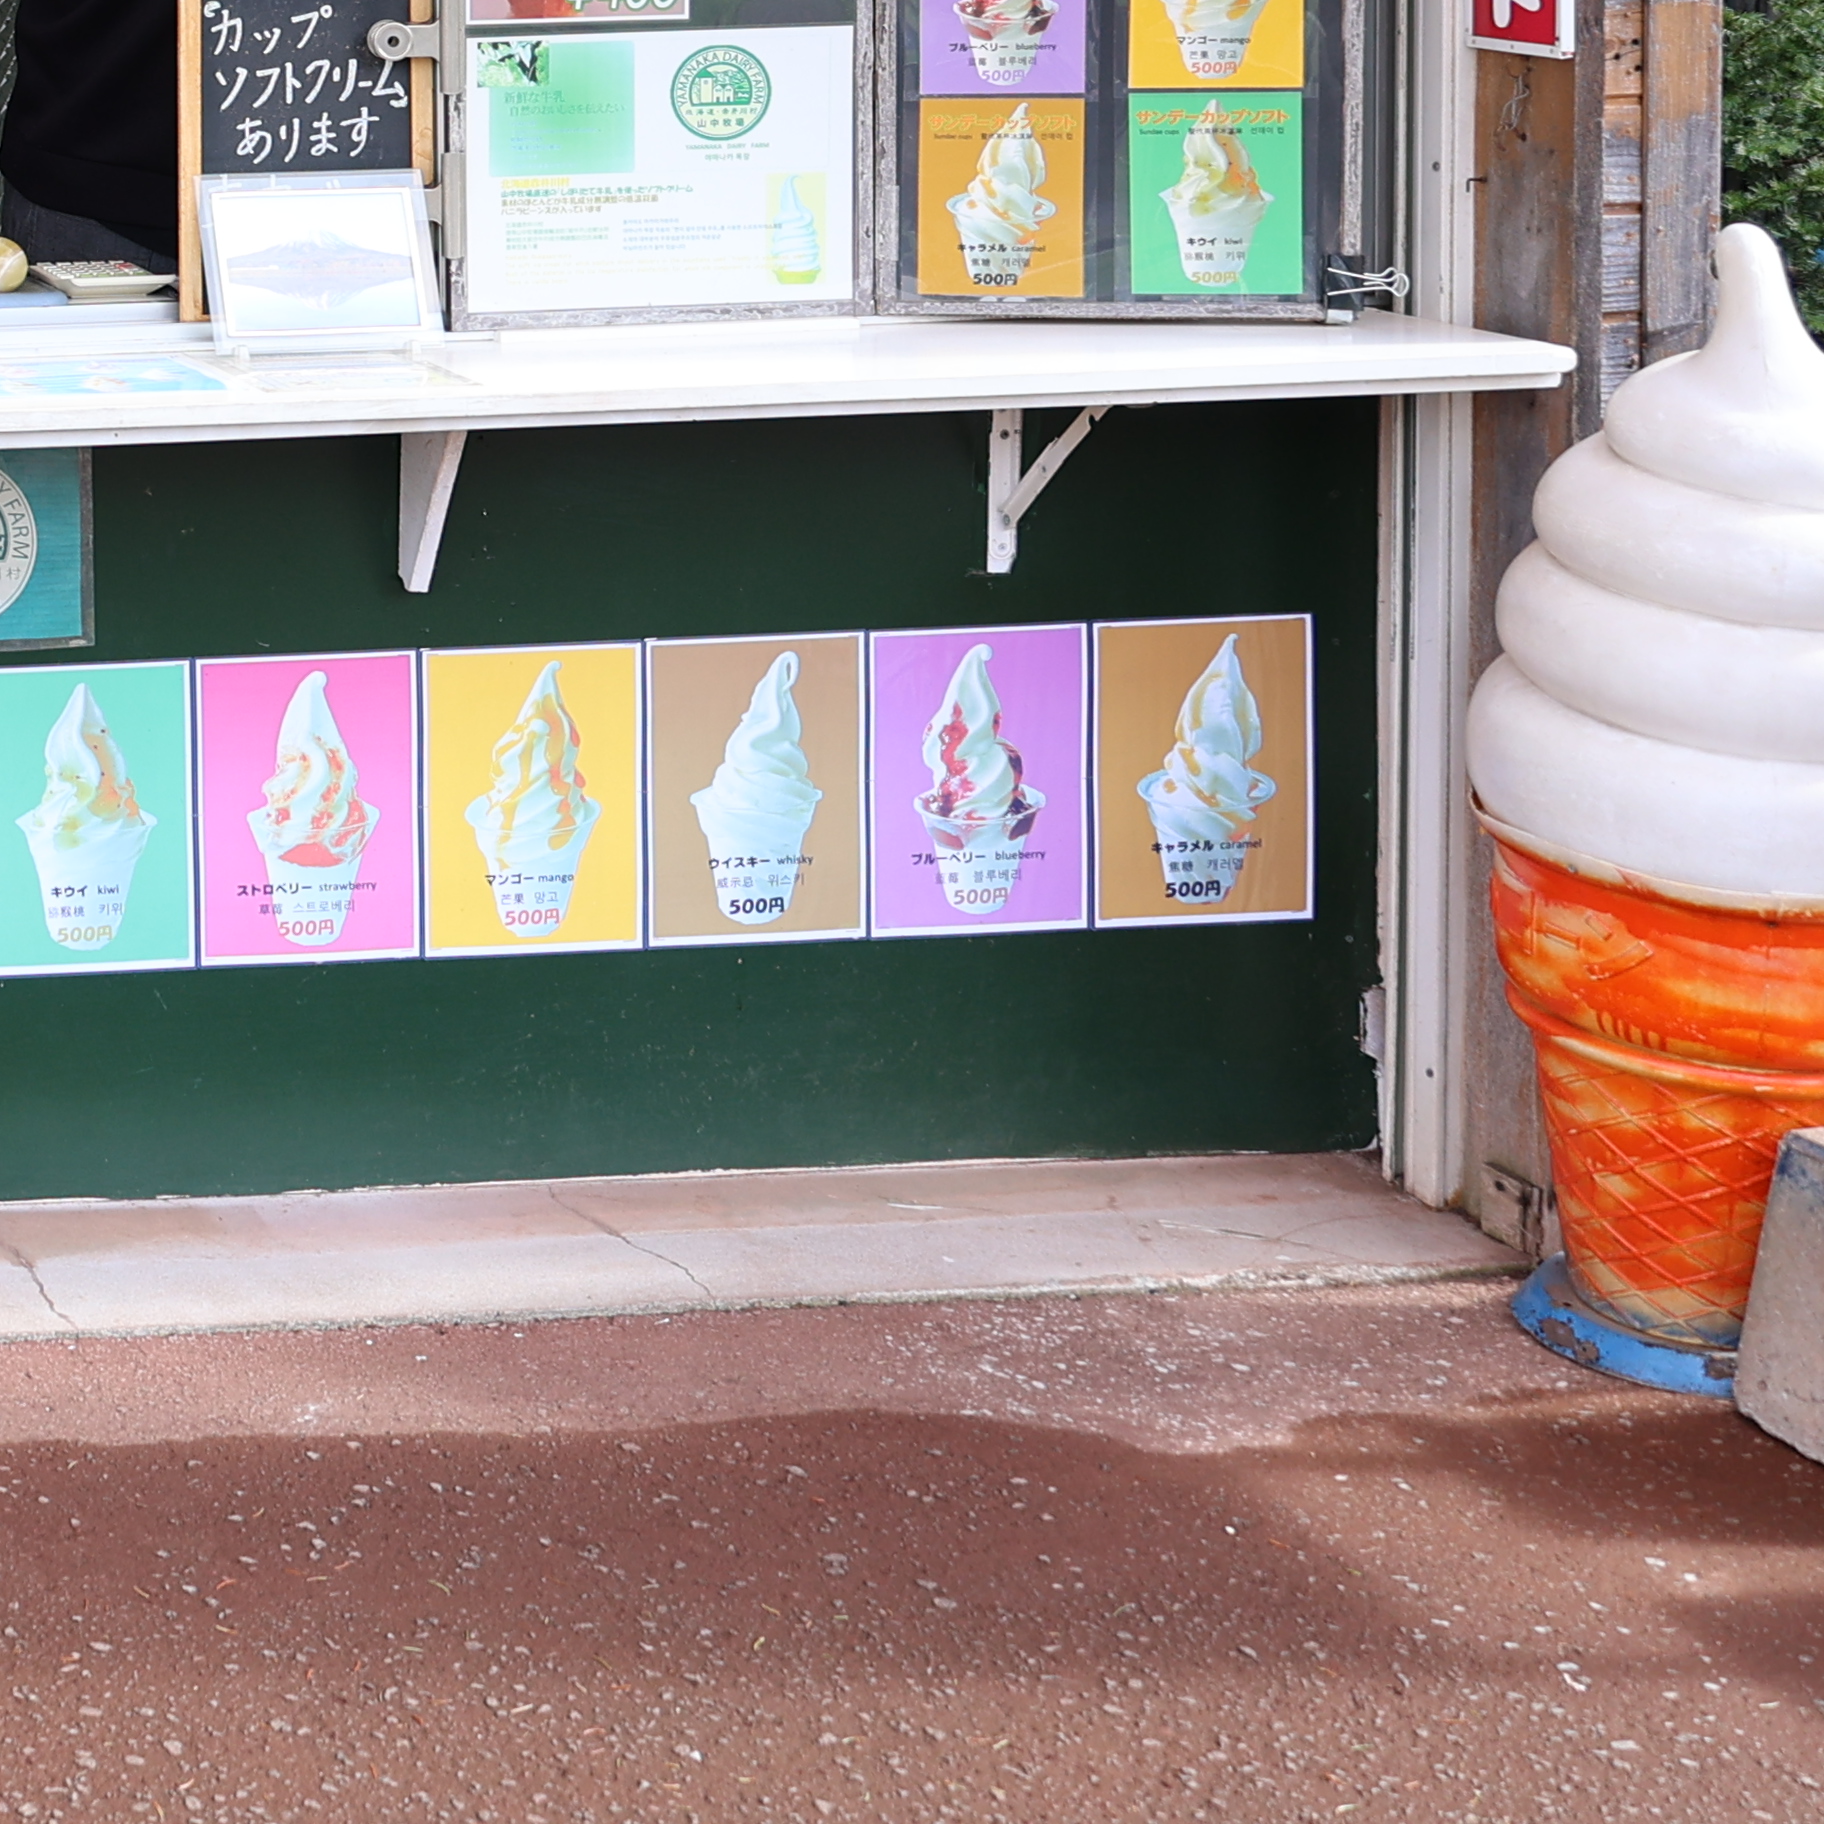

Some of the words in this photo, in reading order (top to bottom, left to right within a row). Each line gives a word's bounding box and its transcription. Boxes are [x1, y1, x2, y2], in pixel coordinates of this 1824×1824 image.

[948, 41, 1009, 53] ブルーベリー
[1014, 42, 1058, 52] blueberry
[1176, 35, 1218, 46] マンゴー
[1219, 36, 1252, 46] mango
[980, 69, 1026, 83] 500円
[1189, 60, 1238, 75] 500円
[676, 52, 720, 108] YAMANAKA
[722, 51, 756, 71] DAIRY
[749, 71, 764, 106] FARM
[696, 117, 745, 128] 山中牧場
[1135, 108, 1290, 126] サンデーカップソフト
[235, 105, 381, 165] あります
[956, 243, 1008, 254] キャラメル
[1010, 244, 1047, 253] caramel
[1186, 237, 1218, 247] キウイ
[1223, 237, 1244, 246] kiwi
[972, 272, 1019, 286] 500円
[1190, 270, 1238, 284] 500円
[2, 497, 31, 561] FARM
[1151, 839, 1214, 855] キャラメル
[1219, 837, 1263, 851] caramel
[708, 856, 771, 871] ウイスキー
[776, 853, 815, 866] whisky
[911, 851, 987, 866] ブルーベリー
[994, 849, 1047, 861] blueberry
[484, 872, 535, 887] マンゴー
[537, 873, 575, 884] mango
[50, 885, 88, 899] キウイ
[97, 884, 120, 895] kiwi
[236, 882, 313, 897] ストロベリー
[318, 880, 378, 893] strawberry
[953, 886, 1009, 906] 500円
[1164, 879, 1221, 899] 500円
[728, 895, 786, 915] 500円
[504, 907, 561, 927] 500円
[57, 924, 114, 944] 500円
[278, 918, 336, 937] 500円
